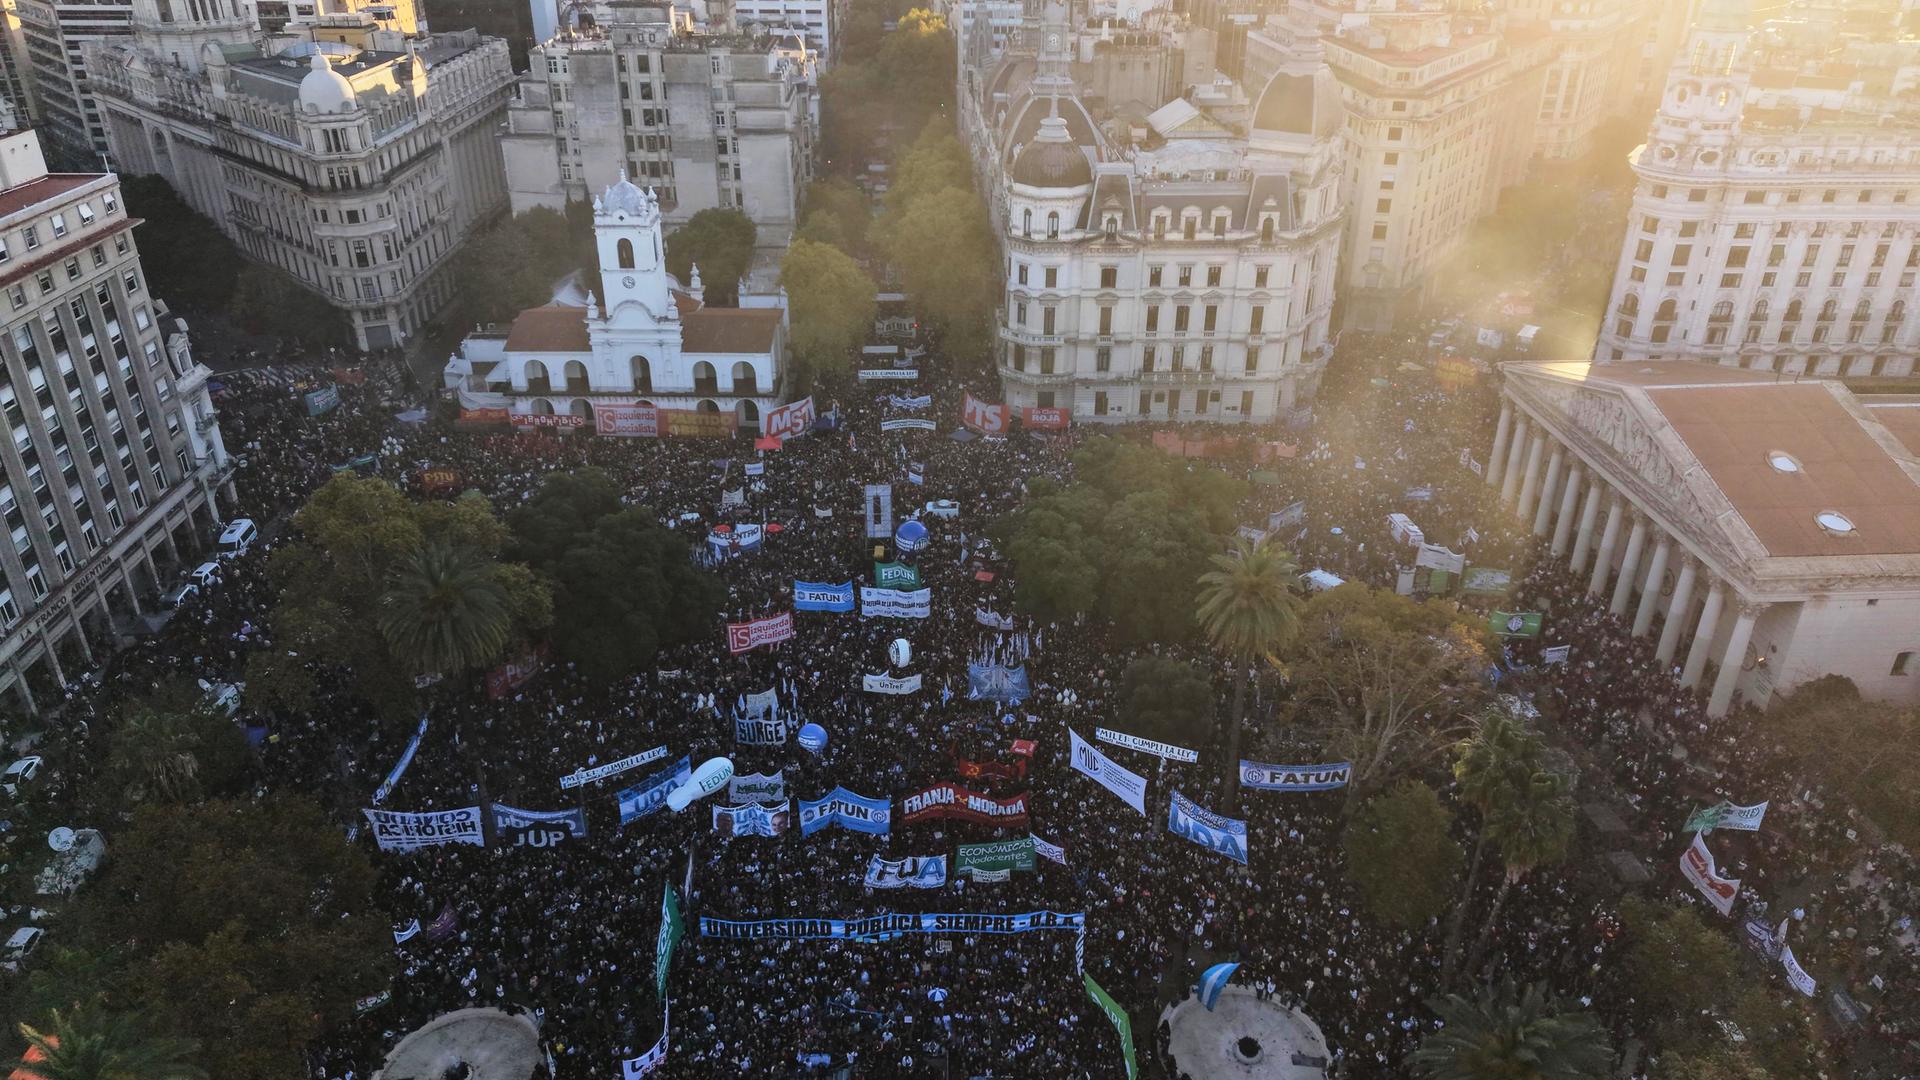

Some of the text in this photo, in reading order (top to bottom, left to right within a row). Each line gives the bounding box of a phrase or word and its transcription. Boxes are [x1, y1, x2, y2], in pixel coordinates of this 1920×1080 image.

[964, 393, 1002, 431] PTS
[882, 566, 915, 581] FEDUN
[35, 595, 67, 626] FRANCO
[71, 556, 112, 594] ARGENTINA
[809, 593, 840, 602] FATUN
[751, 619, 789, 634] izquierda
[751, 628, 790, 643] socialista
[737, 721, 784, 743] SURGE
[648, 747, 663, 760] LEY
[1177, 747, 1192, 759] LEY
[1270, 769, 1347, 784] FATUN
[903, 787, 955, 814] FRANJA
[967, 795, 1025, 816] MORADA
[819, 800, 868, 820] FATUN
[513, 830, 565, 848] JUP
[1170, 801, 1246, 862] UDA
[965, 851, 1027, 866] Nodocentes
[706, 919, 832, 938] UNIVERSIDAD
[935, 914, 1015, 932] SIEMPRE
